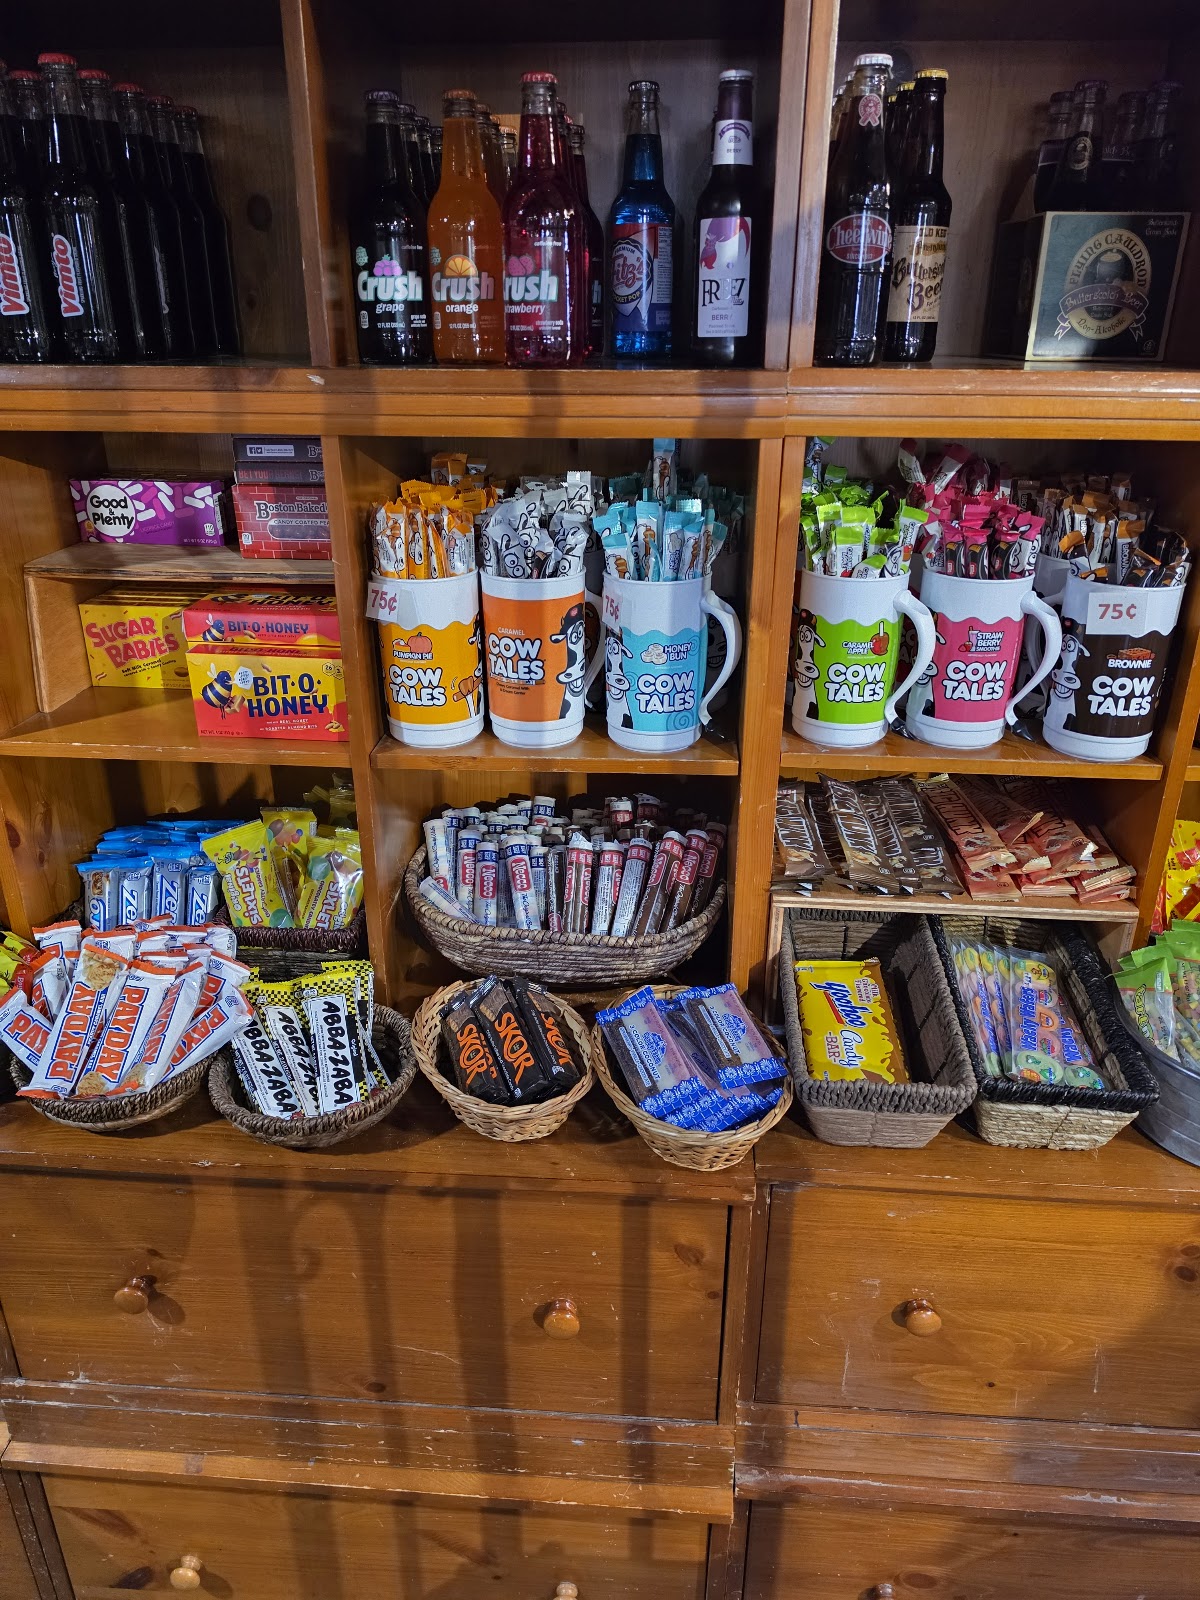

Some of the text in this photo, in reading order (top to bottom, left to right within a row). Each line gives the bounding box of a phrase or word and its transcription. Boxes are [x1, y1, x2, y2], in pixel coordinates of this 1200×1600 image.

[1069, 233, 1148, 288] FLYING CAULDRON
[0, 236, 28, 314] Vimto
[53, 236, 83, 316] Vimto
[357, 270, 423, 301] Crush
[431, 271, 494, 301] Crush
[503, 269, 559, 302] rush
[375, 303, 405, 314] grape
[445, 303, 479, 315] orange
[1065, 289, 1120, 308] Butterscotch
[89, 494, 129, 509] Good
[254, 501, 325, 520] Boston Baked
[92, 512, 135, 529] Plenty
[1121, 543, 1130, 579] BROWNI
[371, 588, 398, 616] 75¢
[604, 594, 620, 621] 75¢
[1098, 603, 1137, 620] 75¢
[85, 617, 157, 648] SUGAR
[497, 626, 526, 636] CARAMEL
[976, 630, 1005, 640] STRAW
[977, 638, 1003, 648] BERRY
[104, 633, 180, 670] BABIES
[393, 650, 433, 660] PUMPKIN PIE
[488, 632, 543, 660] COW
[664, 642, 692, 653] HONEY
[669, 651, 687, 661] BUN
[842, 641, 875, 649] CARAMEL
[847, 647, 868, 655] APPLE
[388, 664, 443, 687] COW
[488, 651, 546, 681] TALES
[827, 661, 887, 684] COW
[946, 660, 1008, 682] COW
[1107, 658, 1153, 669] BROWNIE
[389, 683, 447, 707] TALES
[636, 669, 694, 695] COW
[824, 681, 886, 704] TALES
[942, 679, 1006, 702] TALES
[1091, 675, 1156, 697] COW
[246, 694, 328, 718] HONEY
[635, 690, 696, 714] TALES
[1087, 694, 1152, 717] TALES
[463, 852, 474, 887] Necco
[510, 858, 531, 891] Necco
[677, 853, 699, 885] Necco
[699, 846, 717, 877] Necco
[480, 864, 496, 899] Necco
[316, 881, 340, 929] SIXLET
[47, 982, 98, 1081] PAYDAY
[97, 985, 150, 1084] PAYDAY
[142, 978, 185, 1064] PAYDAY
[494, 1011, 535, 1086] SKOR
[540, 1012, 572, 1065] SKOR
[840, 1030, 864, 1067] Candy
[321, 1000, 355, 1106] ABBA-ZABA
[456, 1023, 488, 1088] SKOR
[631, 1029, 645, 1049] COLOR
[641, 1050, 660, 1080] COCONUT
